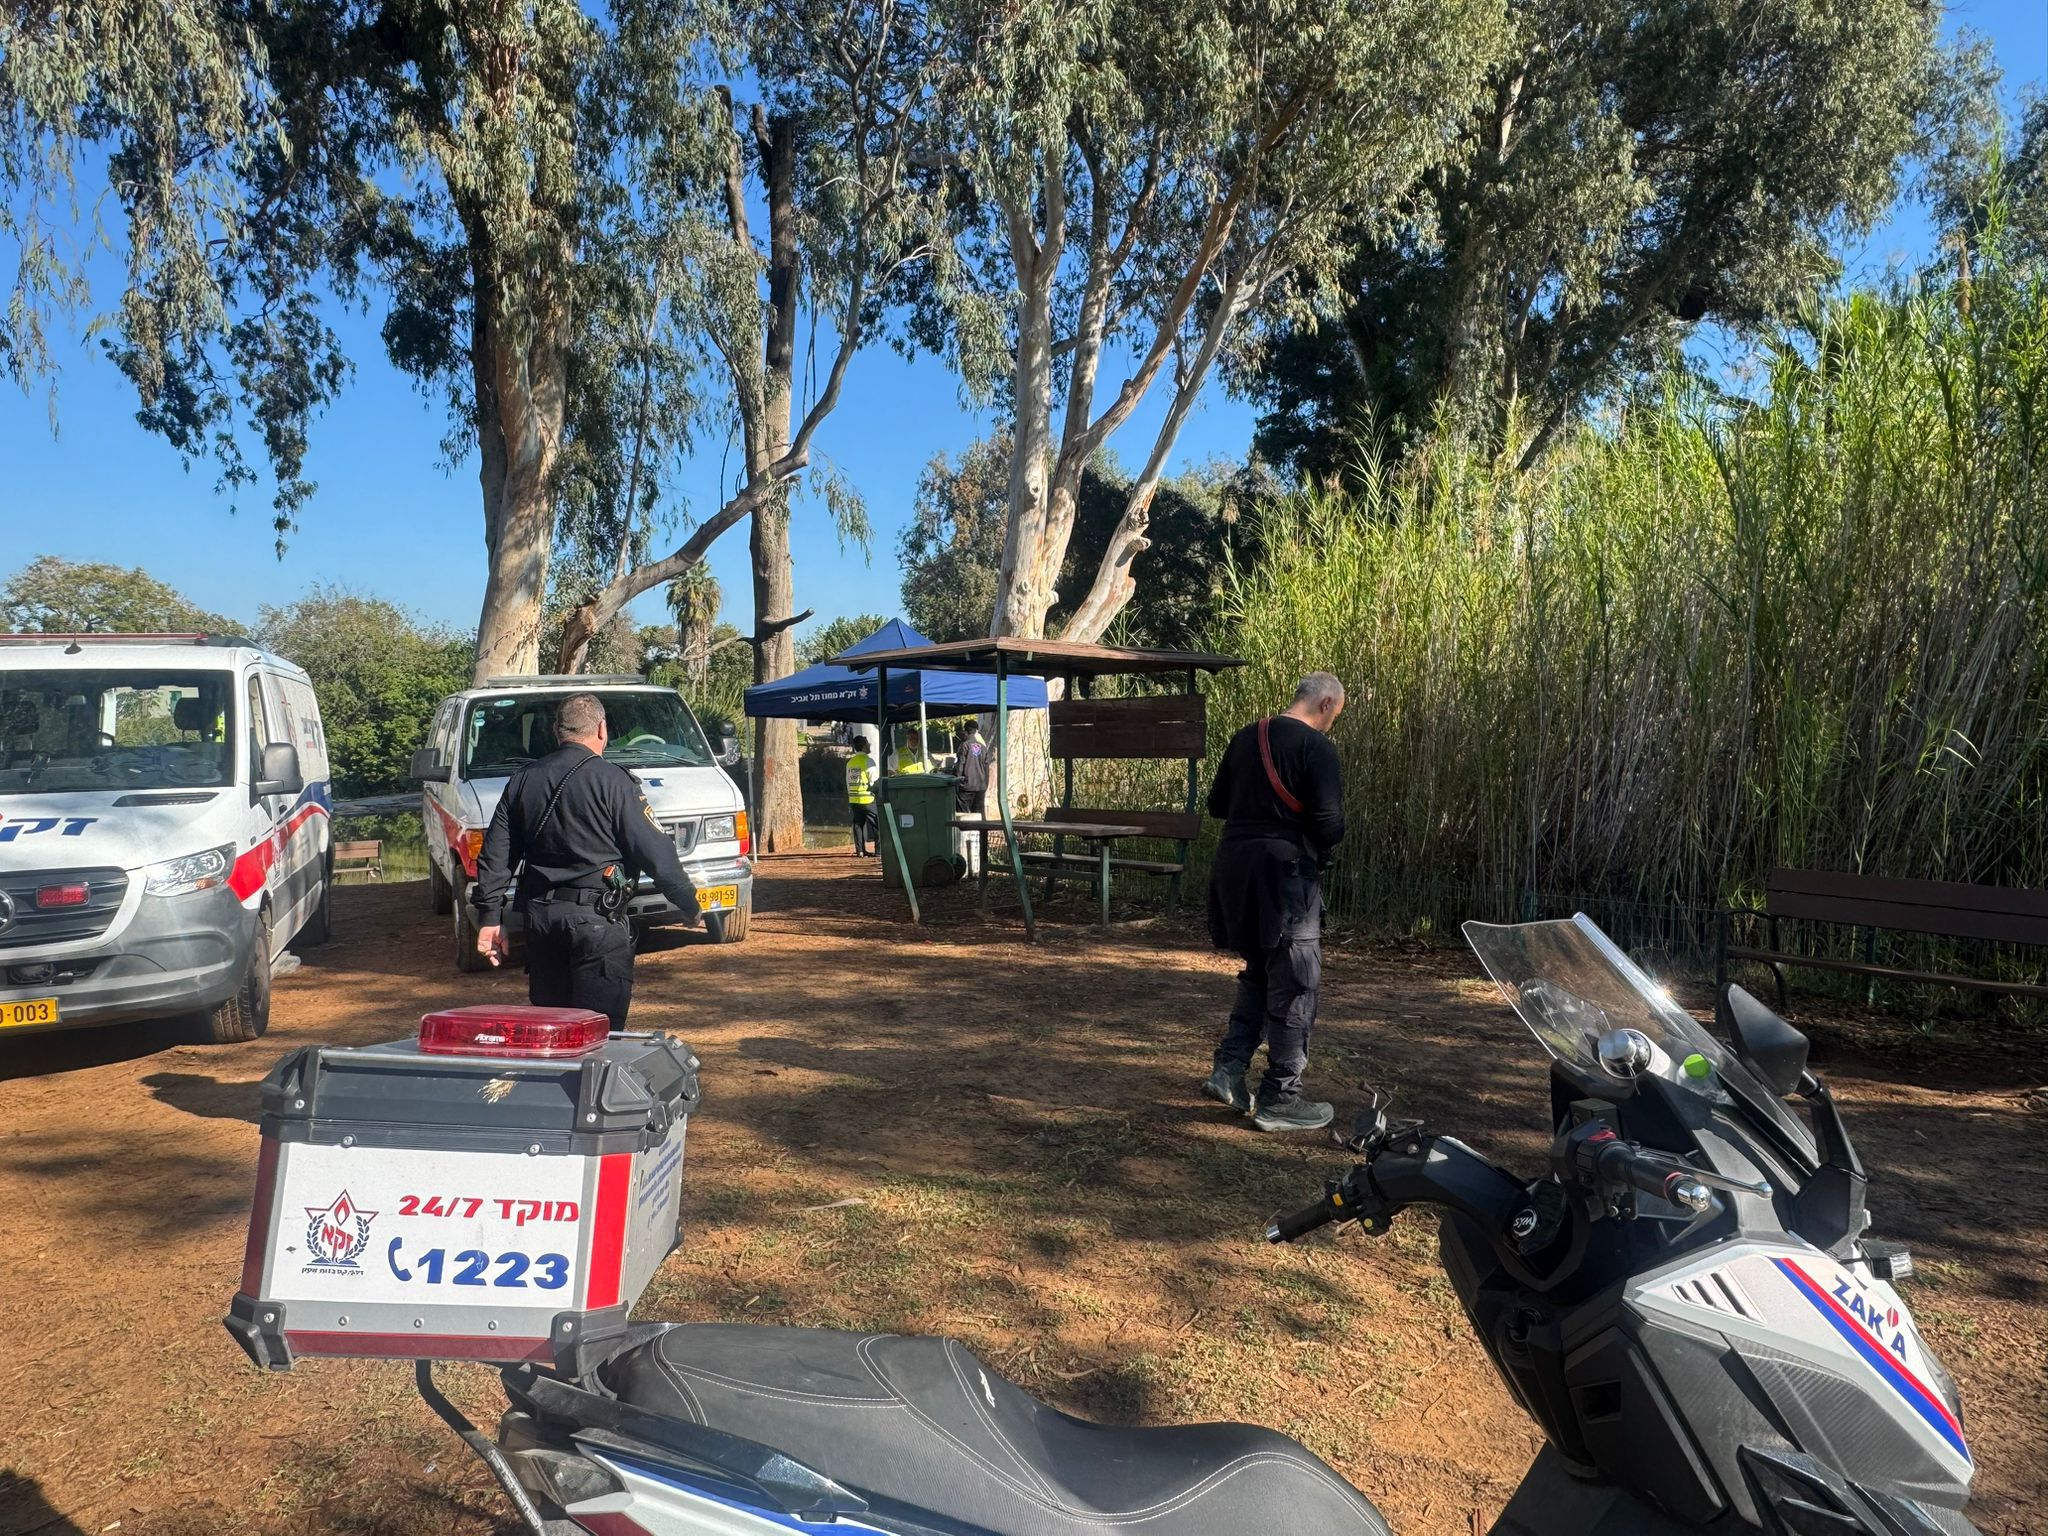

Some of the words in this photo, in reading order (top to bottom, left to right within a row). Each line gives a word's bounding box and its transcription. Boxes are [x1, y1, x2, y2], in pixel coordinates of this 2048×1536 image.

[398, 1195, 484, 1218] 24/7
[492, 1199, 579, 1226] מוקד
[1513, 1216, 1534, 1229] SYM
[417, 1248, 570, 1290] 1223
[1832, 1274, 1907, 1362] ZAKA
